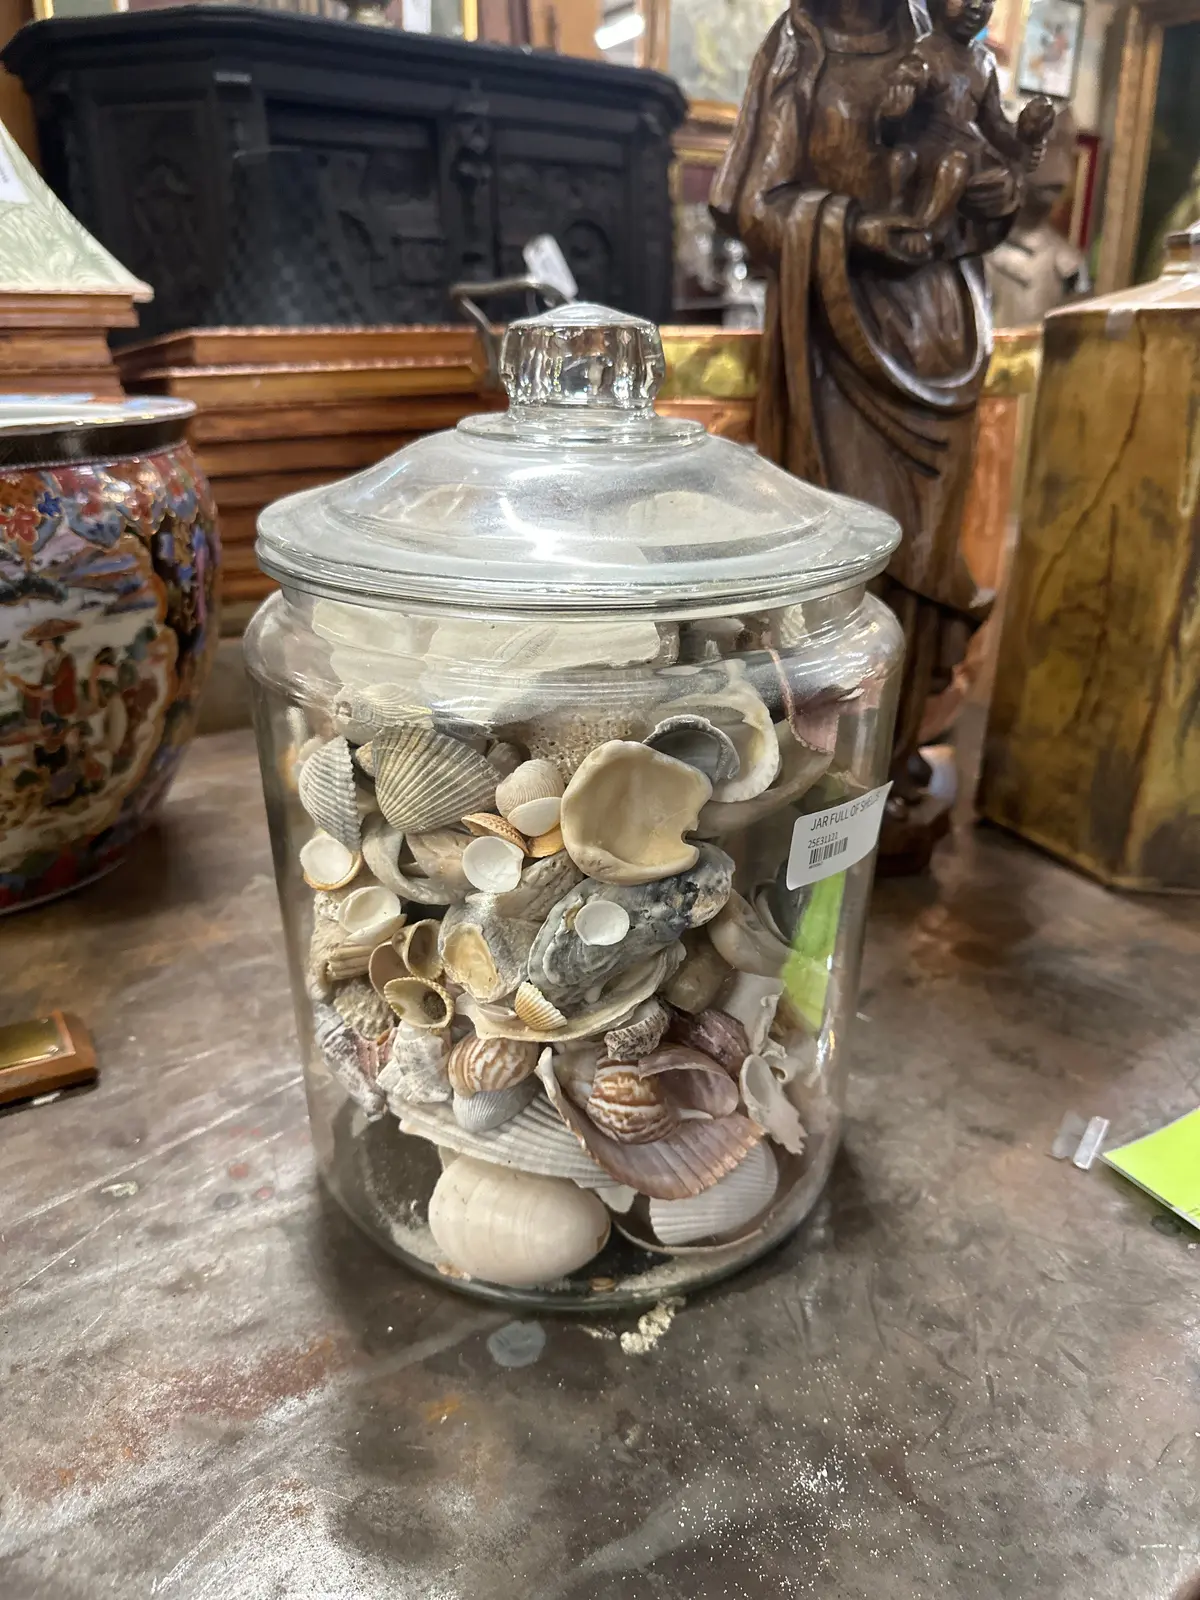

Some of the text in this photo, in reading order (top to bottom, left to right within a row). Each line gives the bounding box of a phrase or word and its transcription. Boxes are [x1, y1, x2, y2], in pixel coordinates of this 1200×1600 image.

[811, 815, 829, 831] JAR
[829, 808, 849, 825] FULL
[850, 802, 861, 817] OF
